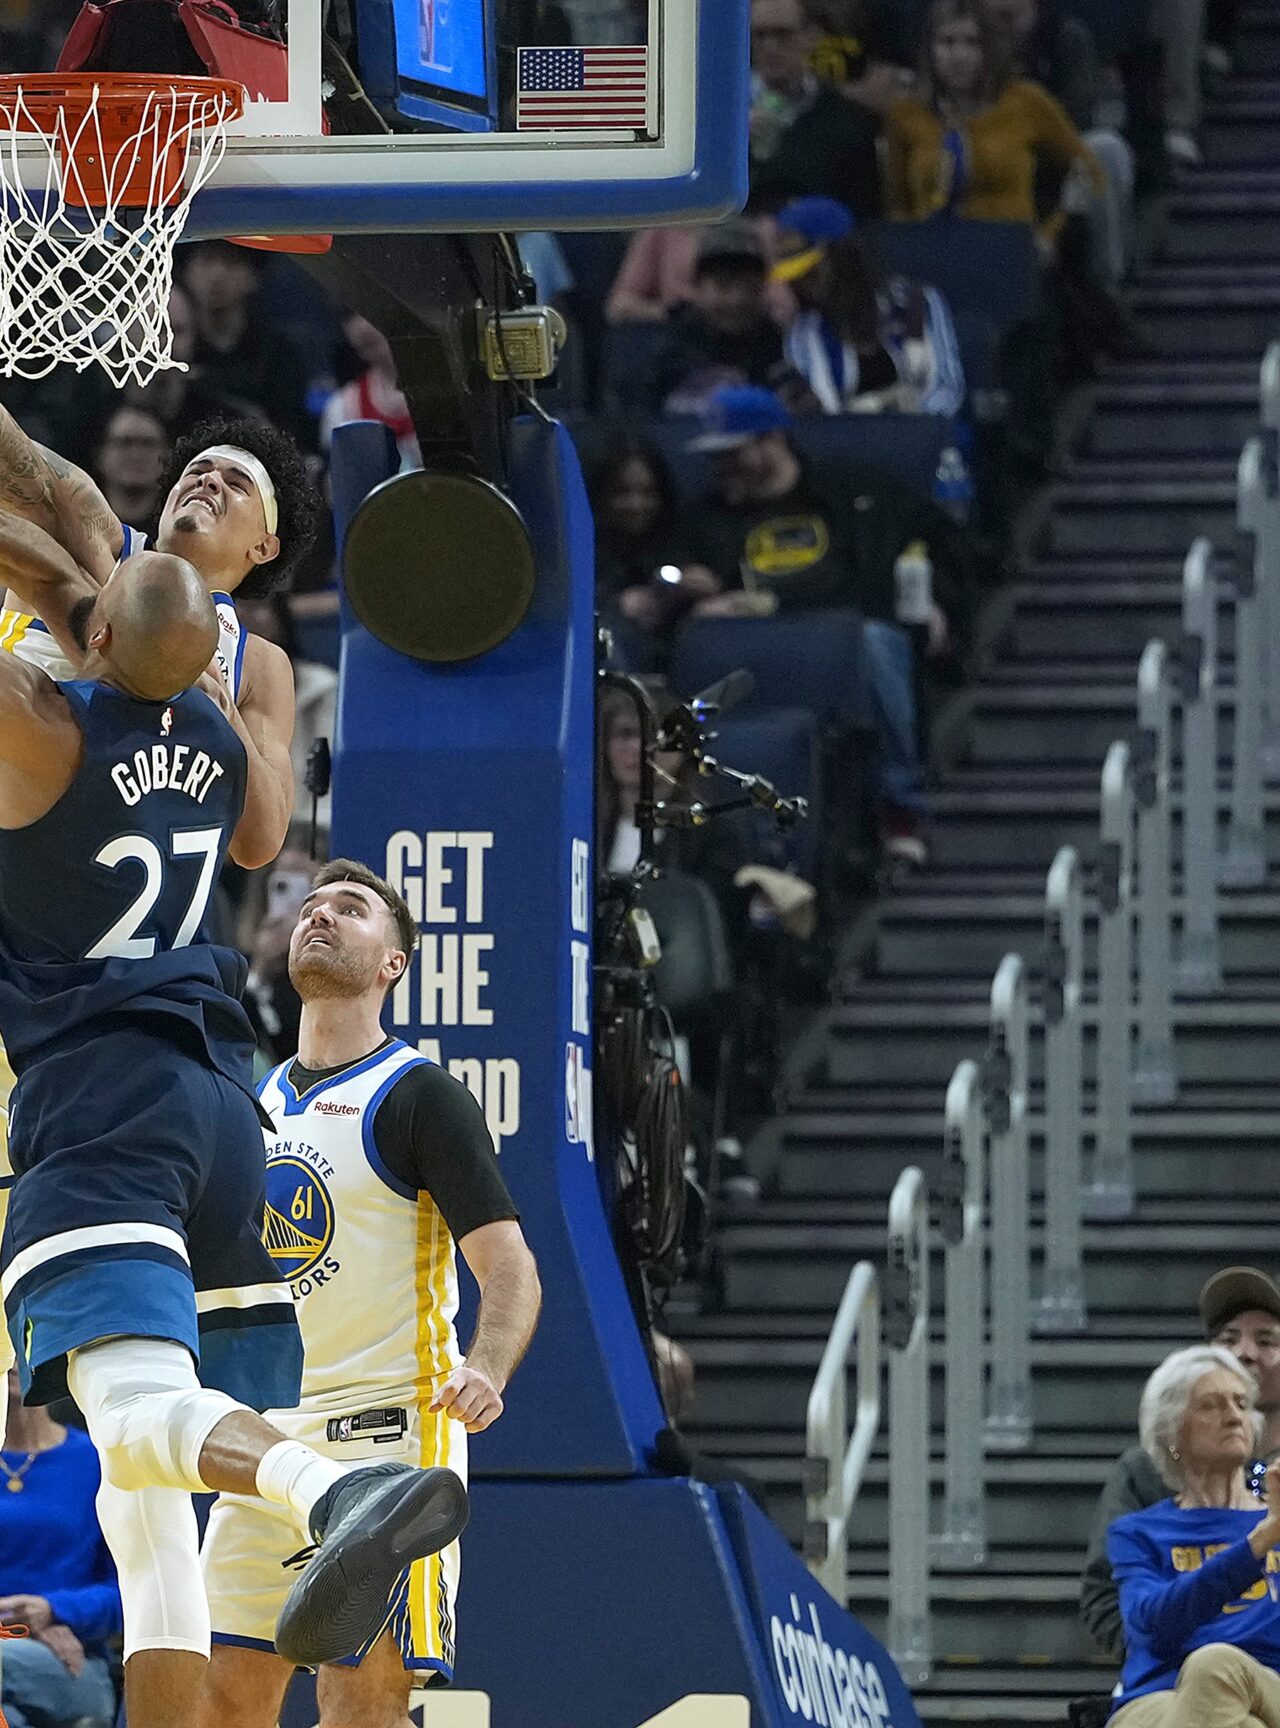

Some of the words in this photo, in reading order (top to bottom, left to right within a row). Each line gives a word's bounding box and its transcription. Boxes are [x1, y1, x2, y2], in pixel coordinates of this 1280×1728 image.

[111, 744, 224, 807] GOBERT
[83, 826, 223, 960] 27
[386, 830, 494, 924] GET
[314, 1101, 360, 1116] Rakuten
[266, 1141, 293, 1159] DEN
[297, 1142, 335, 1180] STATE
[291, 1185, 313, 1220] 61
[291, 1256, 341, 1300] IORS
[771, 1592, 894, 1728] coinbase
